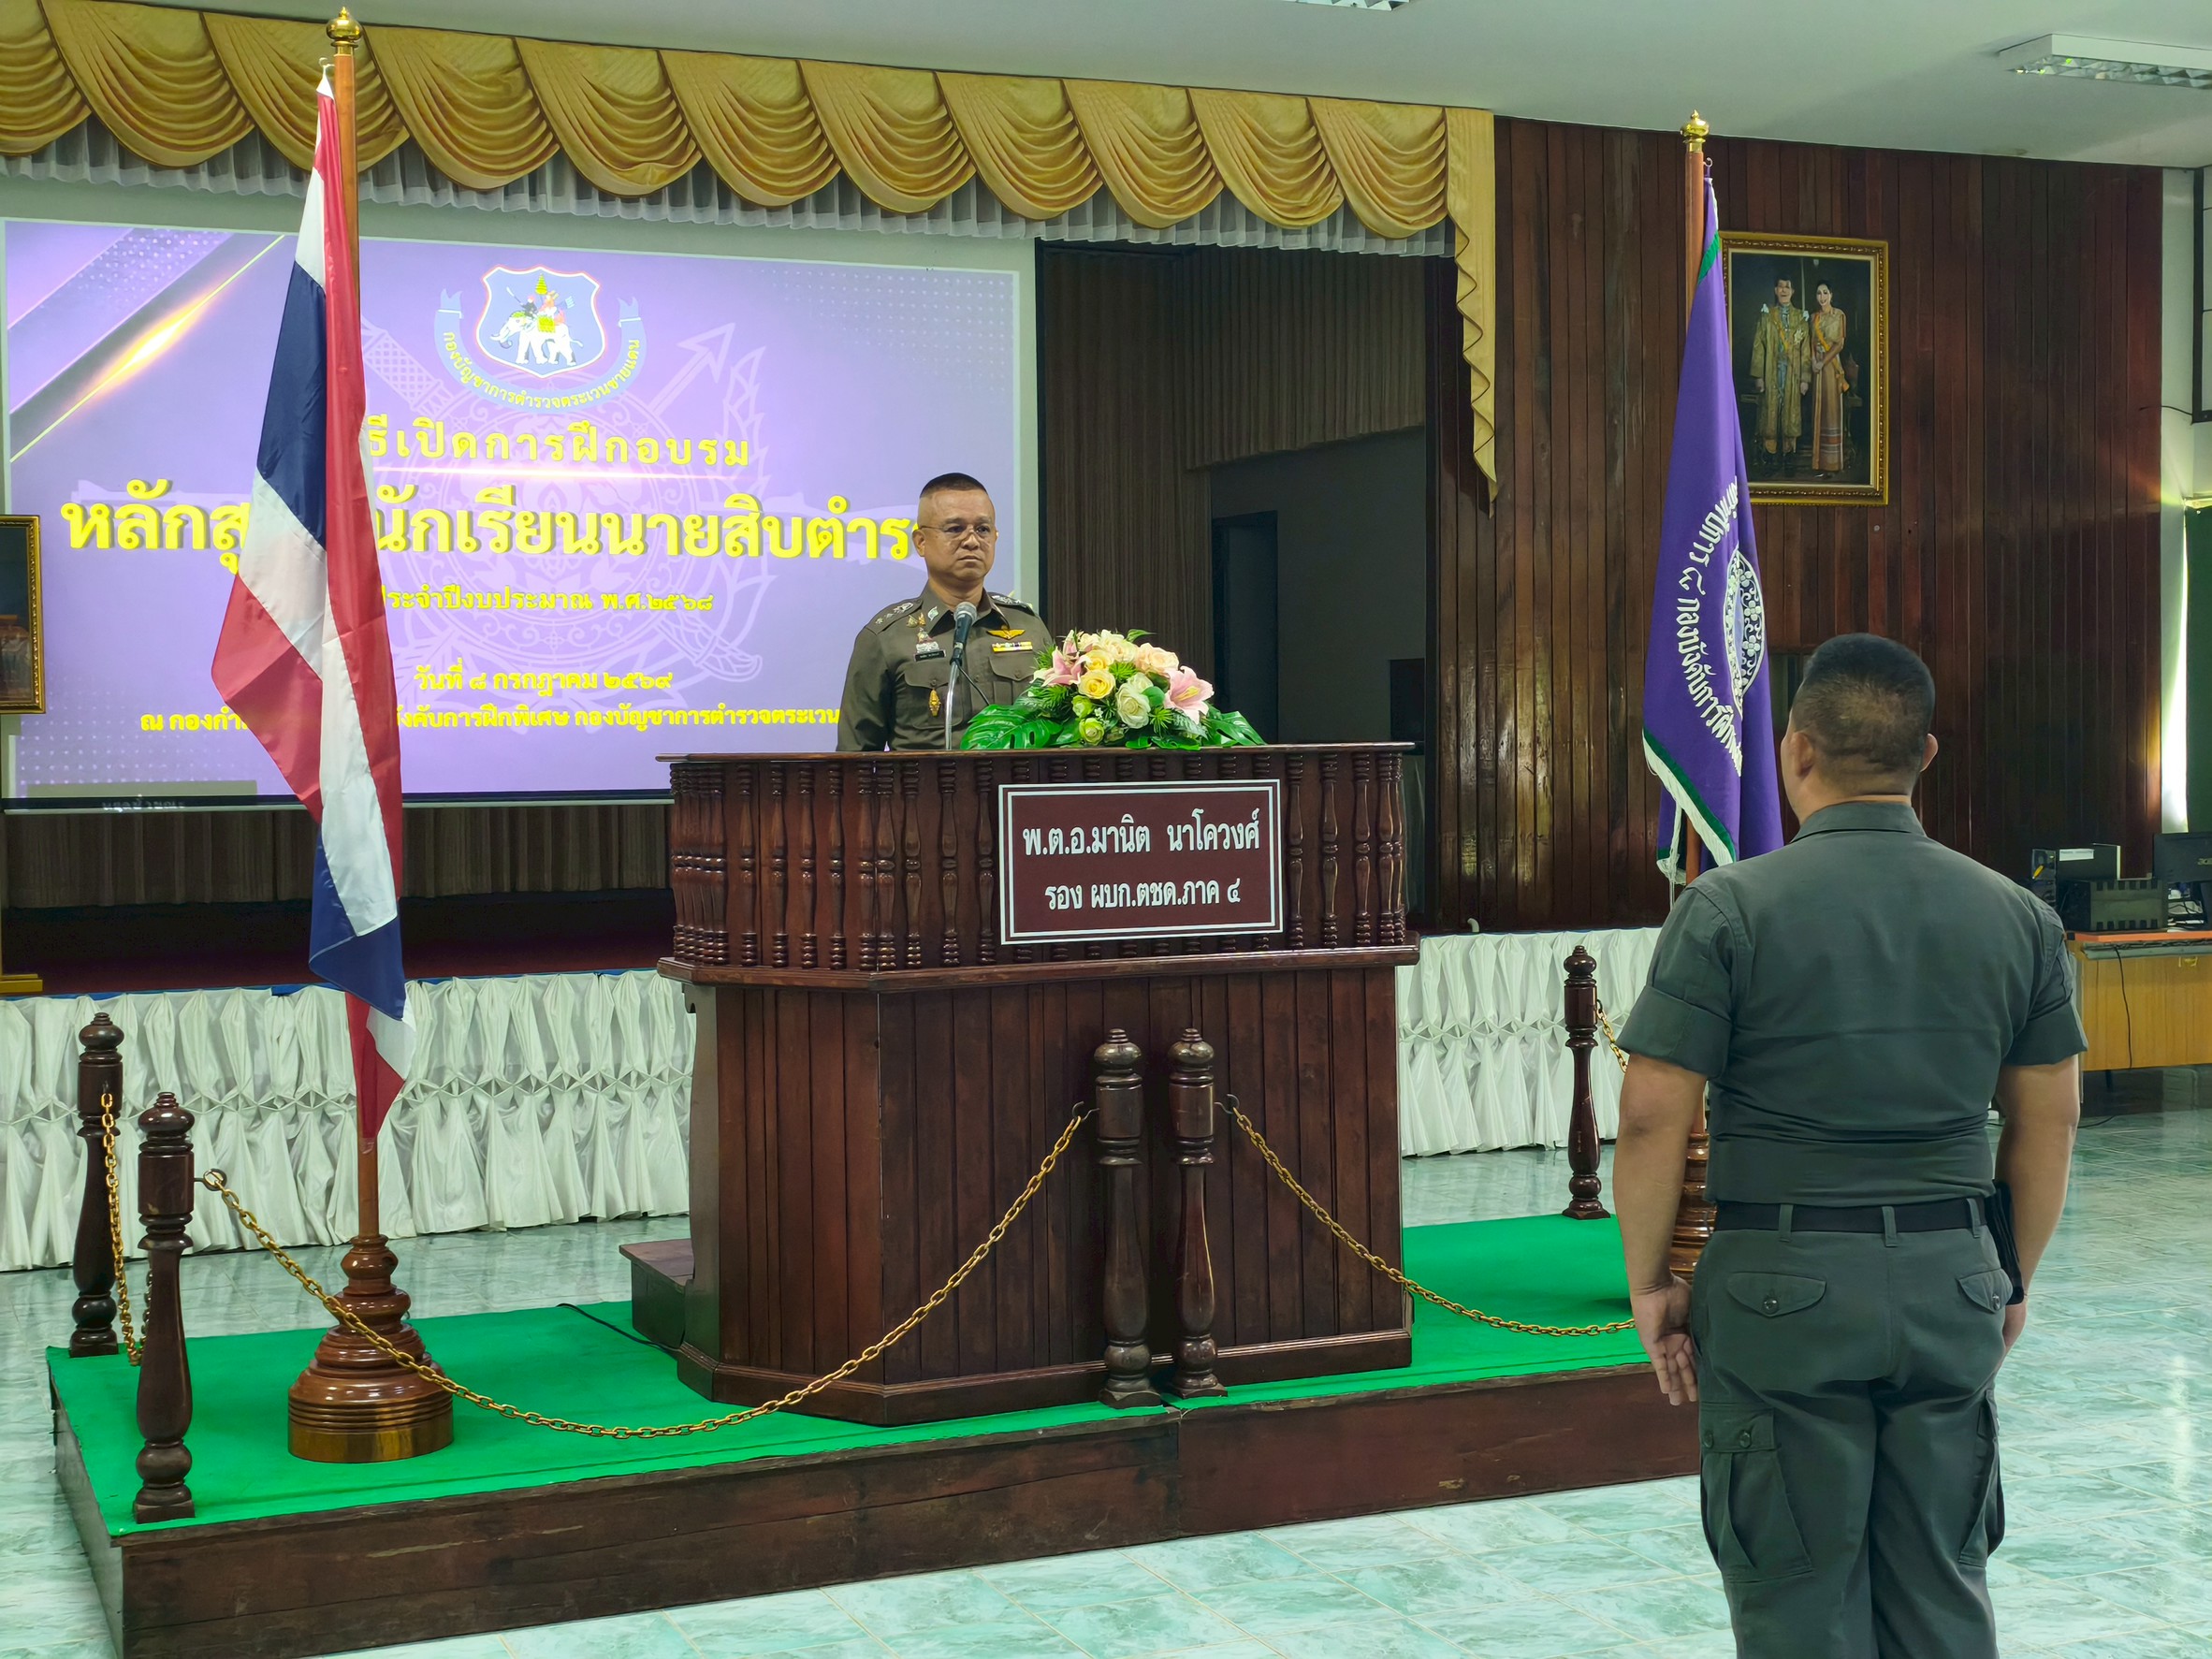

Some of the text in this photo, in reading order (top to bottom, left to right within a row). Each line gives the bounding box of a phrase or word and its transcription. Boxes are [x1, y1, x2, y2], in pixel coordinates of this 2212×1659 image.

[367, 414, 749, 467] ธีเปิดการฝึกอบรม
[61, 478, 921, 575] หลักสู นักเรียนนายสิบตำร
[414, 658, 463, 691] วันที่
[493, 672, 598, 697] กรกฎาคม
[140, 714, 164, 732] ณ
[169, 706, 249, 732] กองกำ
[575, 703, 841, 733] กองบัญชาการตำรวจตระเวน
[1023, 808, 1260, 855] พ.ต.อ.มานิต นาโควงศ์
[1044, 878, 1241, 910] รอง ผบก.ตชด.ภาค ๔
